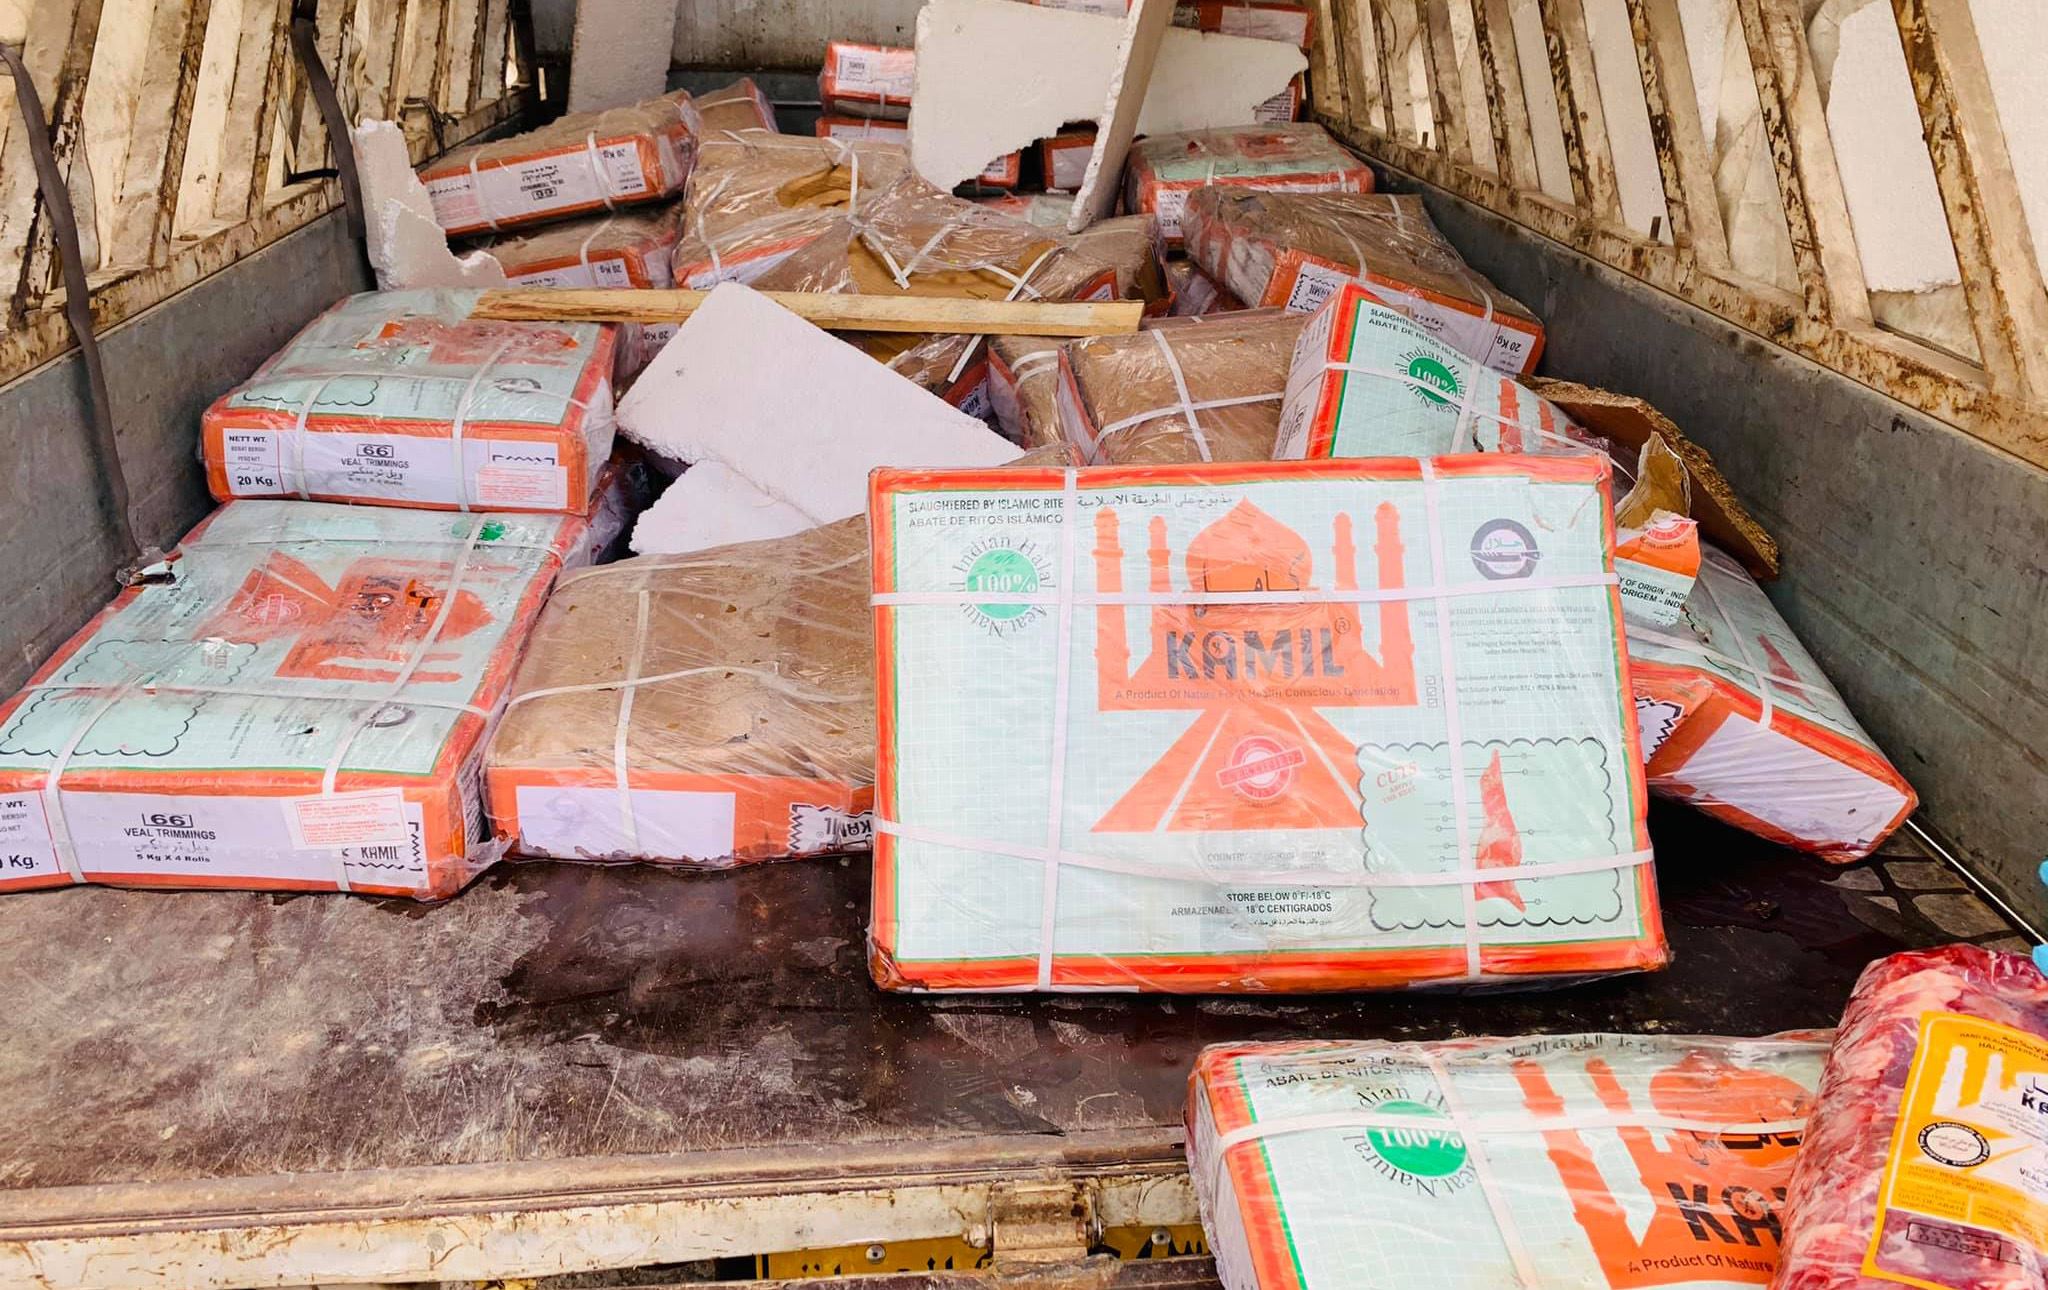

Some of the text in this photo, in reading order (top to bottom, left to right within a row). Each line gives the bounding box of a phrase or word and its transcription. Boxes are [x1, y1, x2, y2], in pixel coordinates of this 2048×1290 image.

[1368, 318, 1400, 332] ABATE
[1400, 327, 1415, 336] DE
[660, 330, 669, 340] 20
[1509, 341, 1522, 353] 20
[1414, 366, 1458, 398] 100%
[229, 435, 251, 443] NETT
[363, 444, 389, 457] 66
[340, 457, 410, 469] VEAL TRIMMINGS
[237, 475, 277, 487] 20 Kg.
[983, 499, 995, 510] BY
[998, 498, 1040, 510] ISLAMIC
[1043, 498, 1064, 509] RITE
[908, 516, 947, 528] ABATE
[949, 516, 966, 526] DE
[969, 514, 1004, 526] RITOS
[951, 536, 1010, 572] Indian
[976, 574, 1036, 593] 100%
[1625, 578, 1637, 587] OF
[1637, 582, 1665, 595] ORIGIN
[1621, 587, 1681, 609] ORIGEM IND
[1166, 627, 1345, 680] KAMIL
[1126, 689, 1167, 700] Product
[1284, 686, 1341, 698] Conscious
[6, 800, 27, 808] WT.
[150, 813, 186, 827] 66
[124, 827, 217, 841] VEAL TRIMMINGS
[824, 817, 872, 838] KAMIL
[146, 853, 161, 862] Kg
[360, 845, 400, 860] KAMIL
[8, 854, 39, 870] Kg.
[1226, 892, 1256, 902] STORE
[1257, 891, 1290, 902] BELOW
[1267, 902, 1333, 914] CENTIGRADOS
[1376, 1127, 1464, 1149] 100%
[1642, 1255, 1702, 1272] Product
[1705, 1254, 1723, 1267] Of
[1726, 1256, 1774, 1273] Nature
